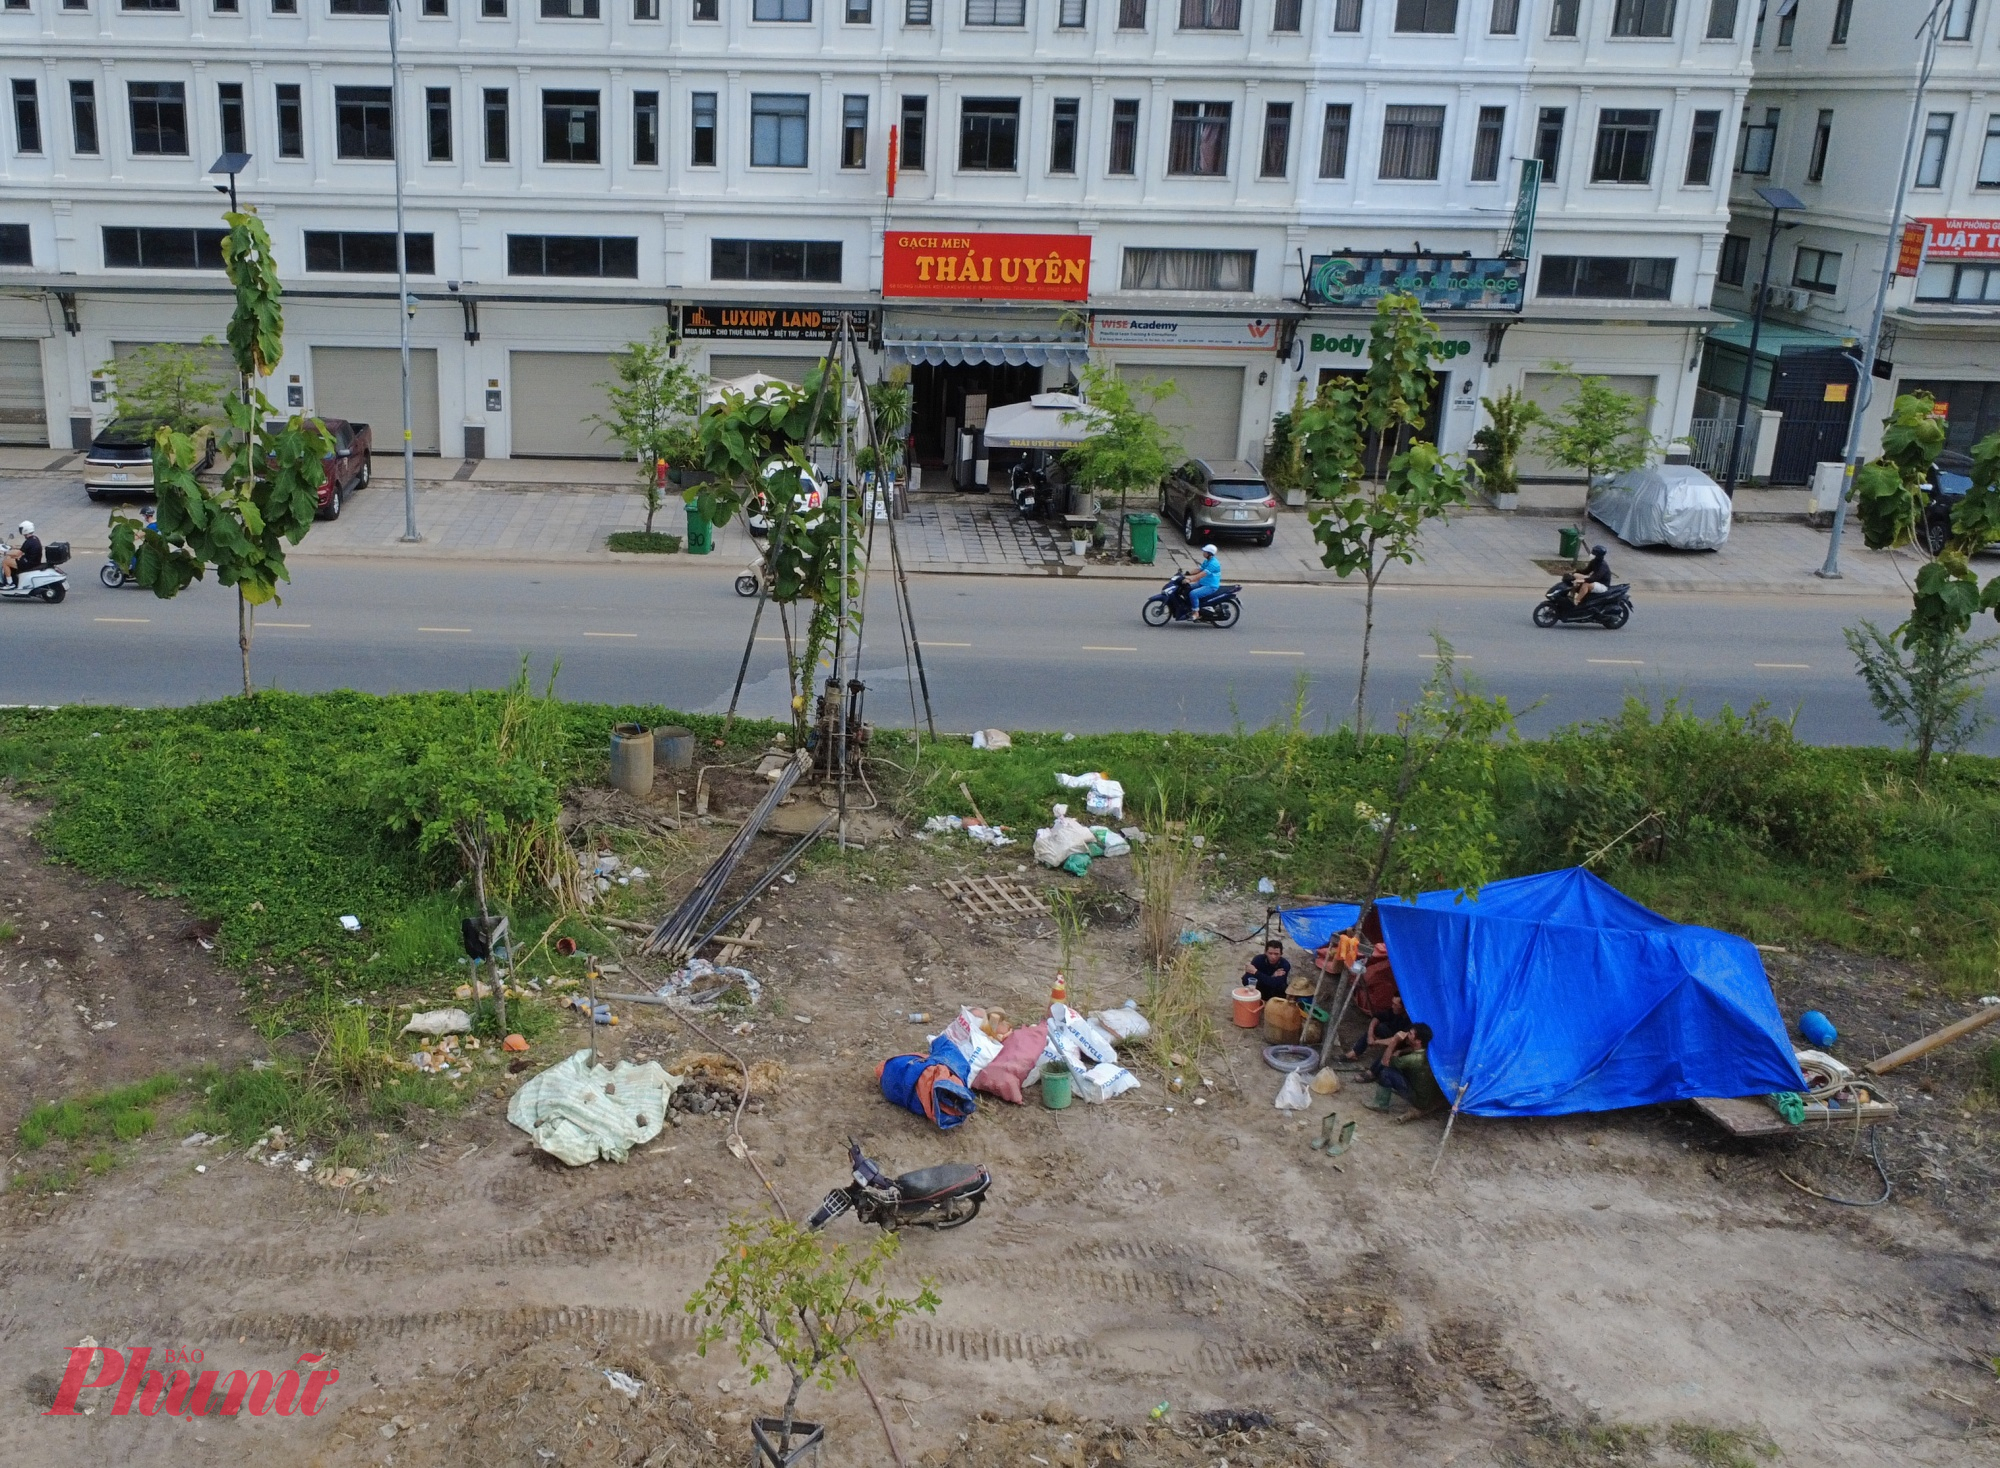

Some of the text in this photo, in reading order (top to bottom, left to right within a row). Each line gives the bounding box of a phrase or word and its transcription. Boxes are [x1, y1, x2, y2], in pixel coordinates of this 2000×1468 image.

[899, 237, 971, 250] GẠCH MEN
[916, 250, 1086, 284] THÁI UYÊN
[721, 310, 776, 326] LUXURY
[782, 311, 821, 327] LAND
[1130, 321, 1178, 332] Academy
[1310, 333, 1365, 357] Body
